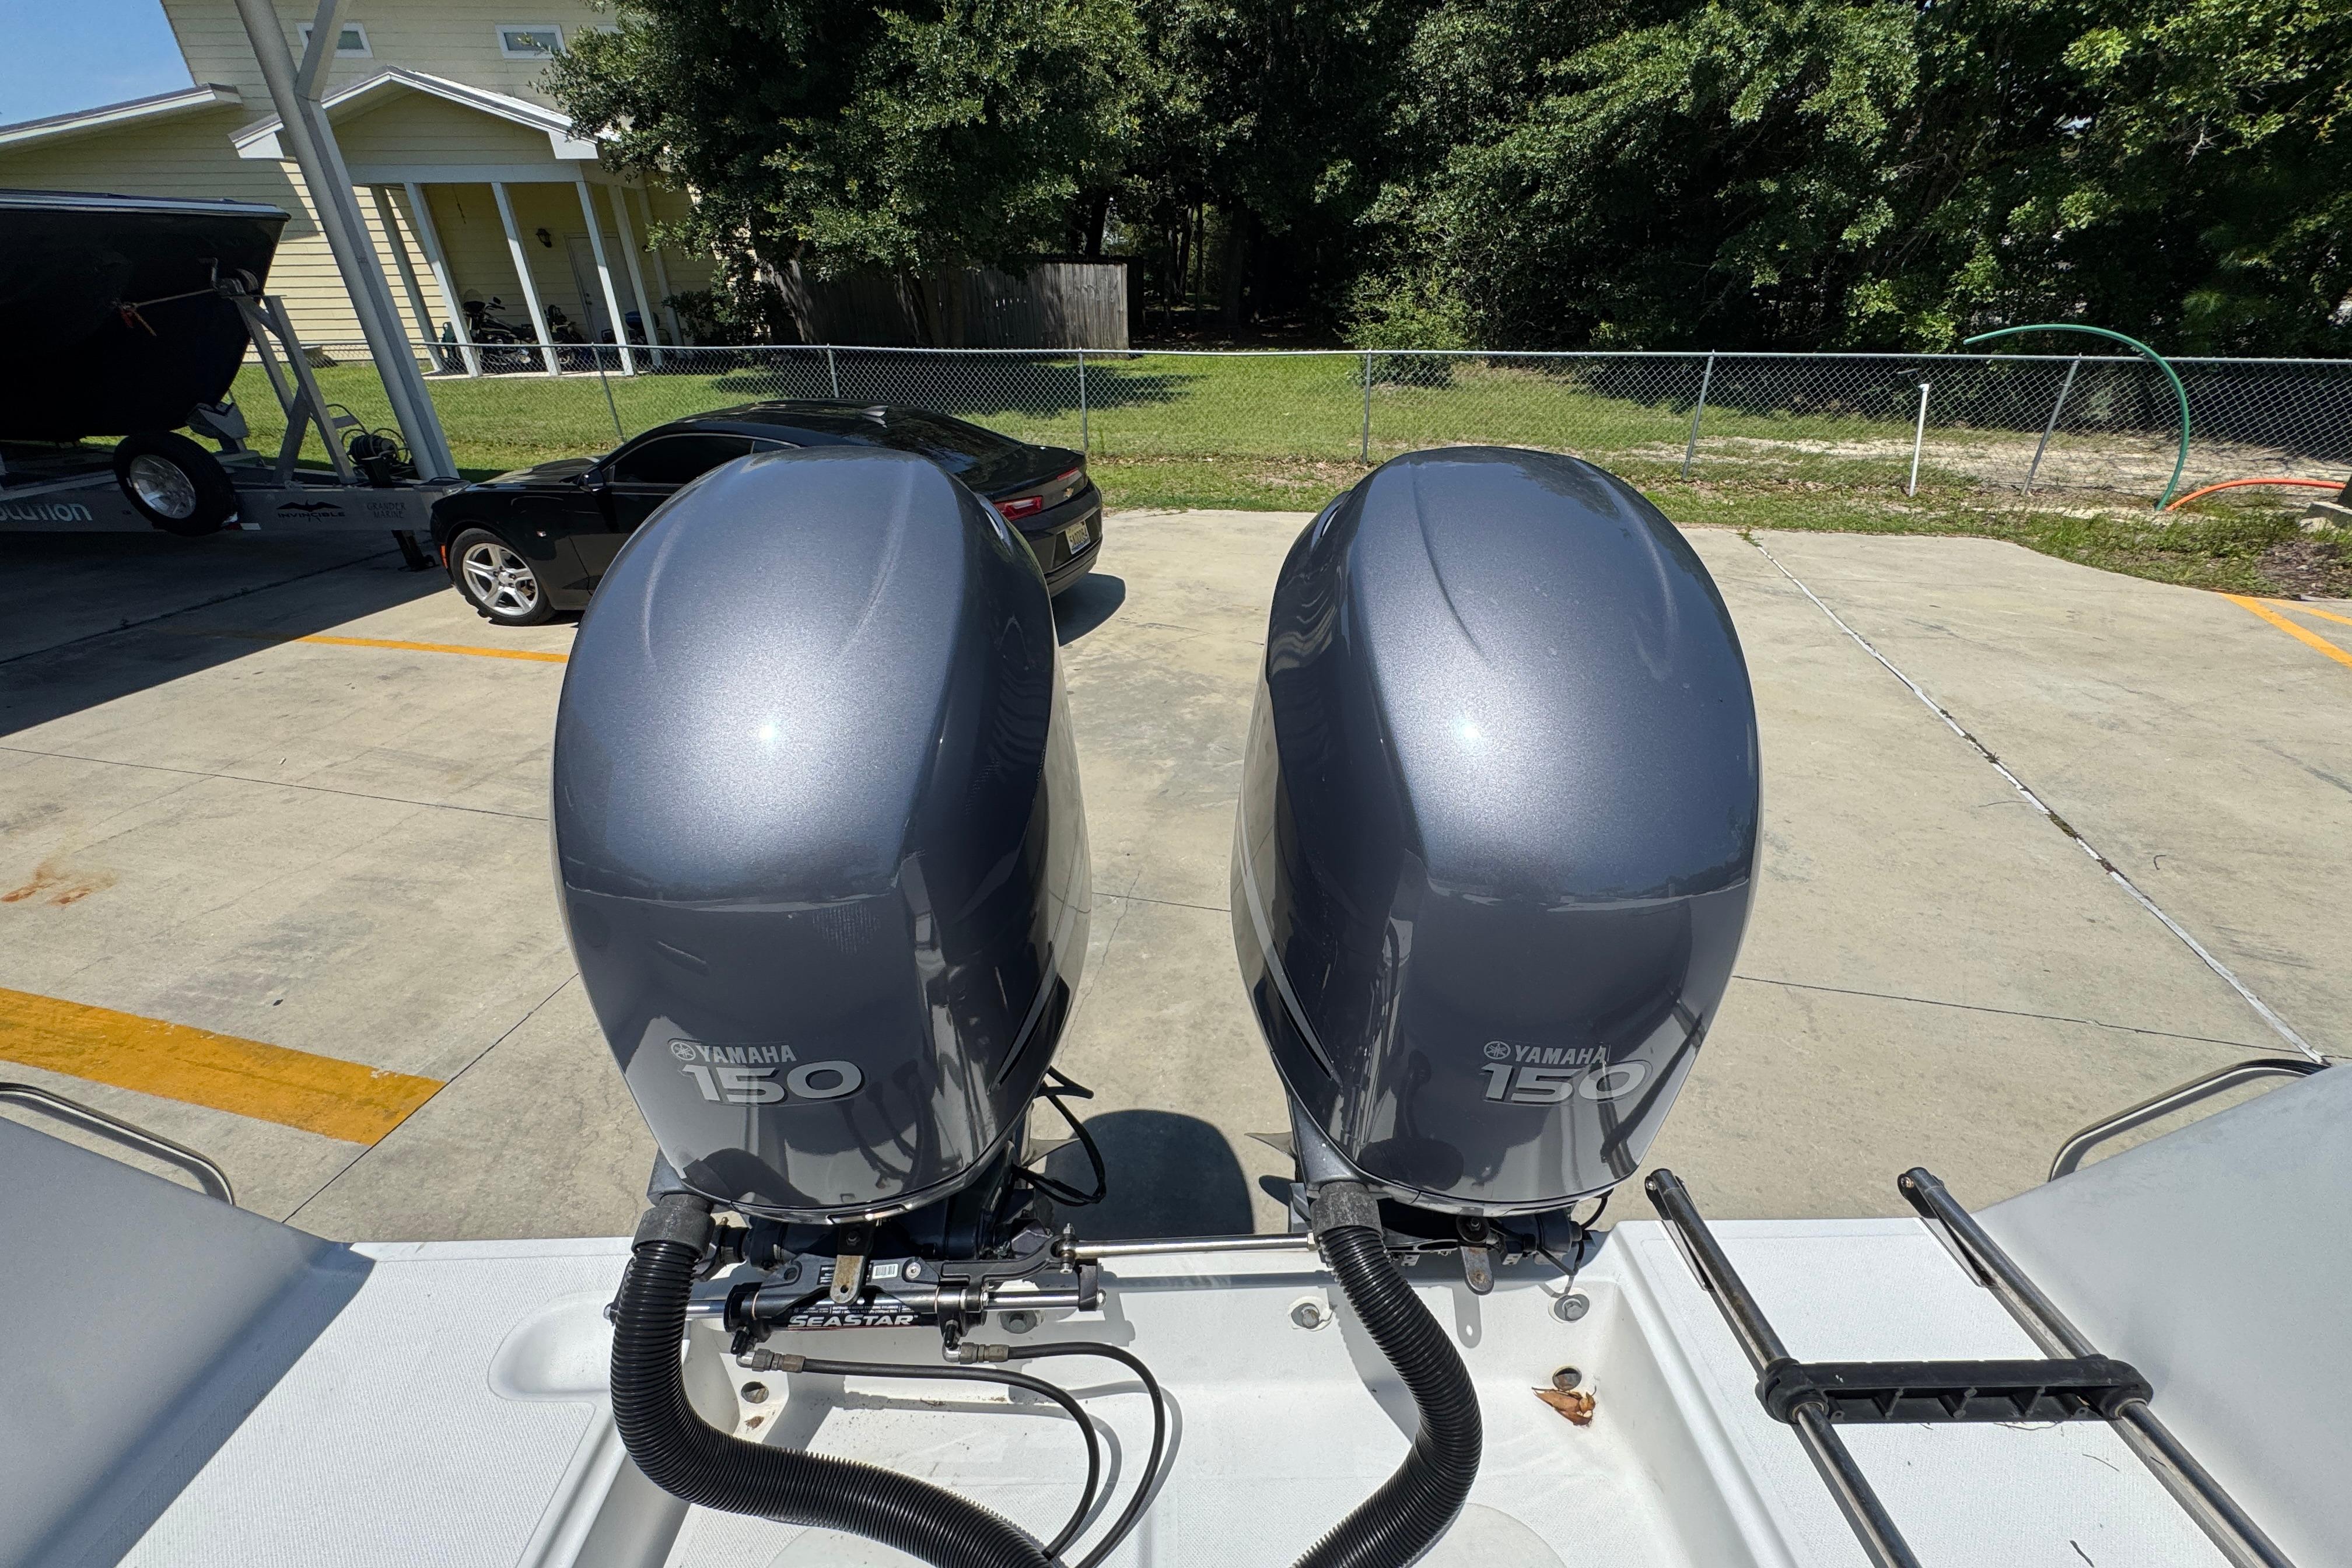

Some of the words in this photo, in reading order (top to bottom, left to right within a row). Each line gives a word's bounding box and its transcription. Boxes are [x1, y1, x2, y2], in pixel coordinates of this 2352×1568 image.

[366, 502, 407, 510] GRANDER
[373, 510, 405, 519] MARINE
[695, 1044, 797, 1063] YAMAHA
[1514, 1045, 1607, 1065] YAMAHA
[682, 1060, 864, 1104] 150
[1480, 1062, 1646, 1103] 150
